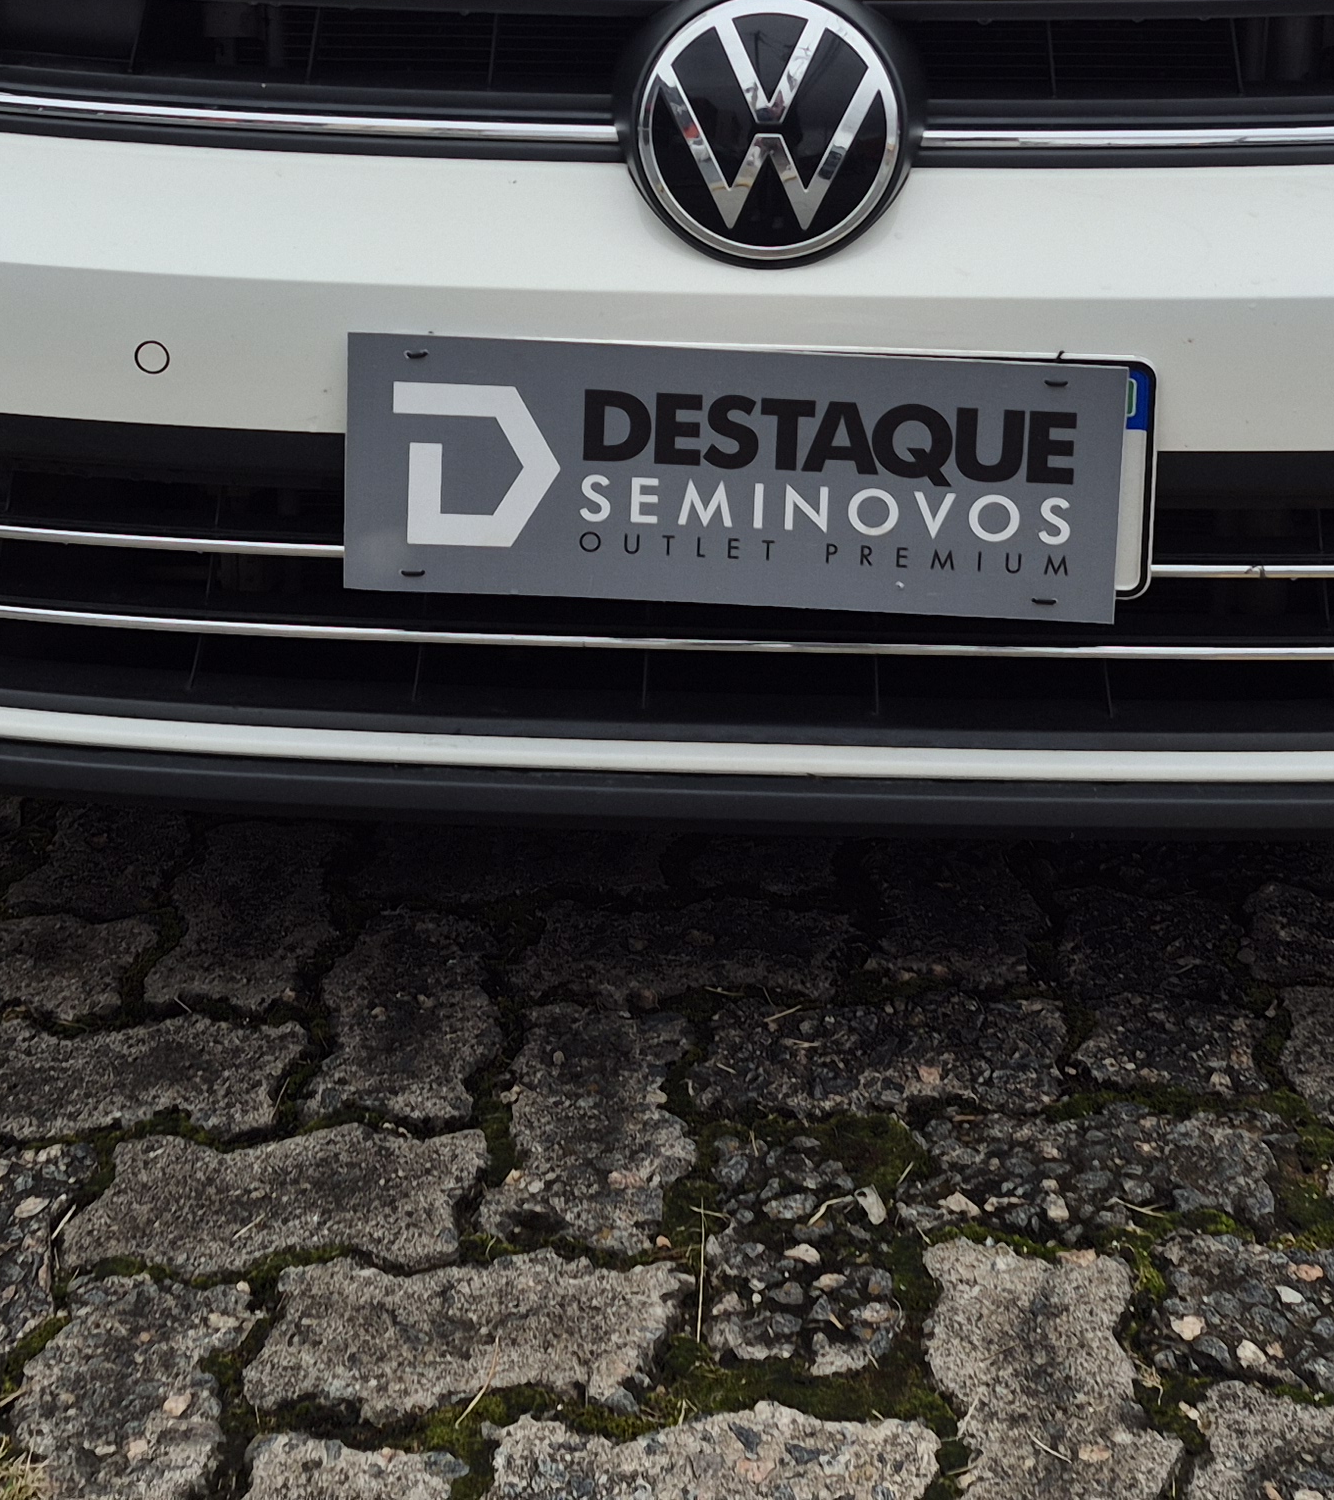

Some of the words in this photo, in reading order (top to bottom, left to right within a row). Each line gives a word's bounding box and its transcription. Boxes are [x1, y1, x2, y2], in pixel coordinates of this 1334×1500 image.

[581, 388, 1077, 487] DESTAQUE
[579, 473, 1071, 546] SEMINOVOS
[579, 530, 776, 562] OUTLET
[824, 542, 1070, 578] PREMIUM
